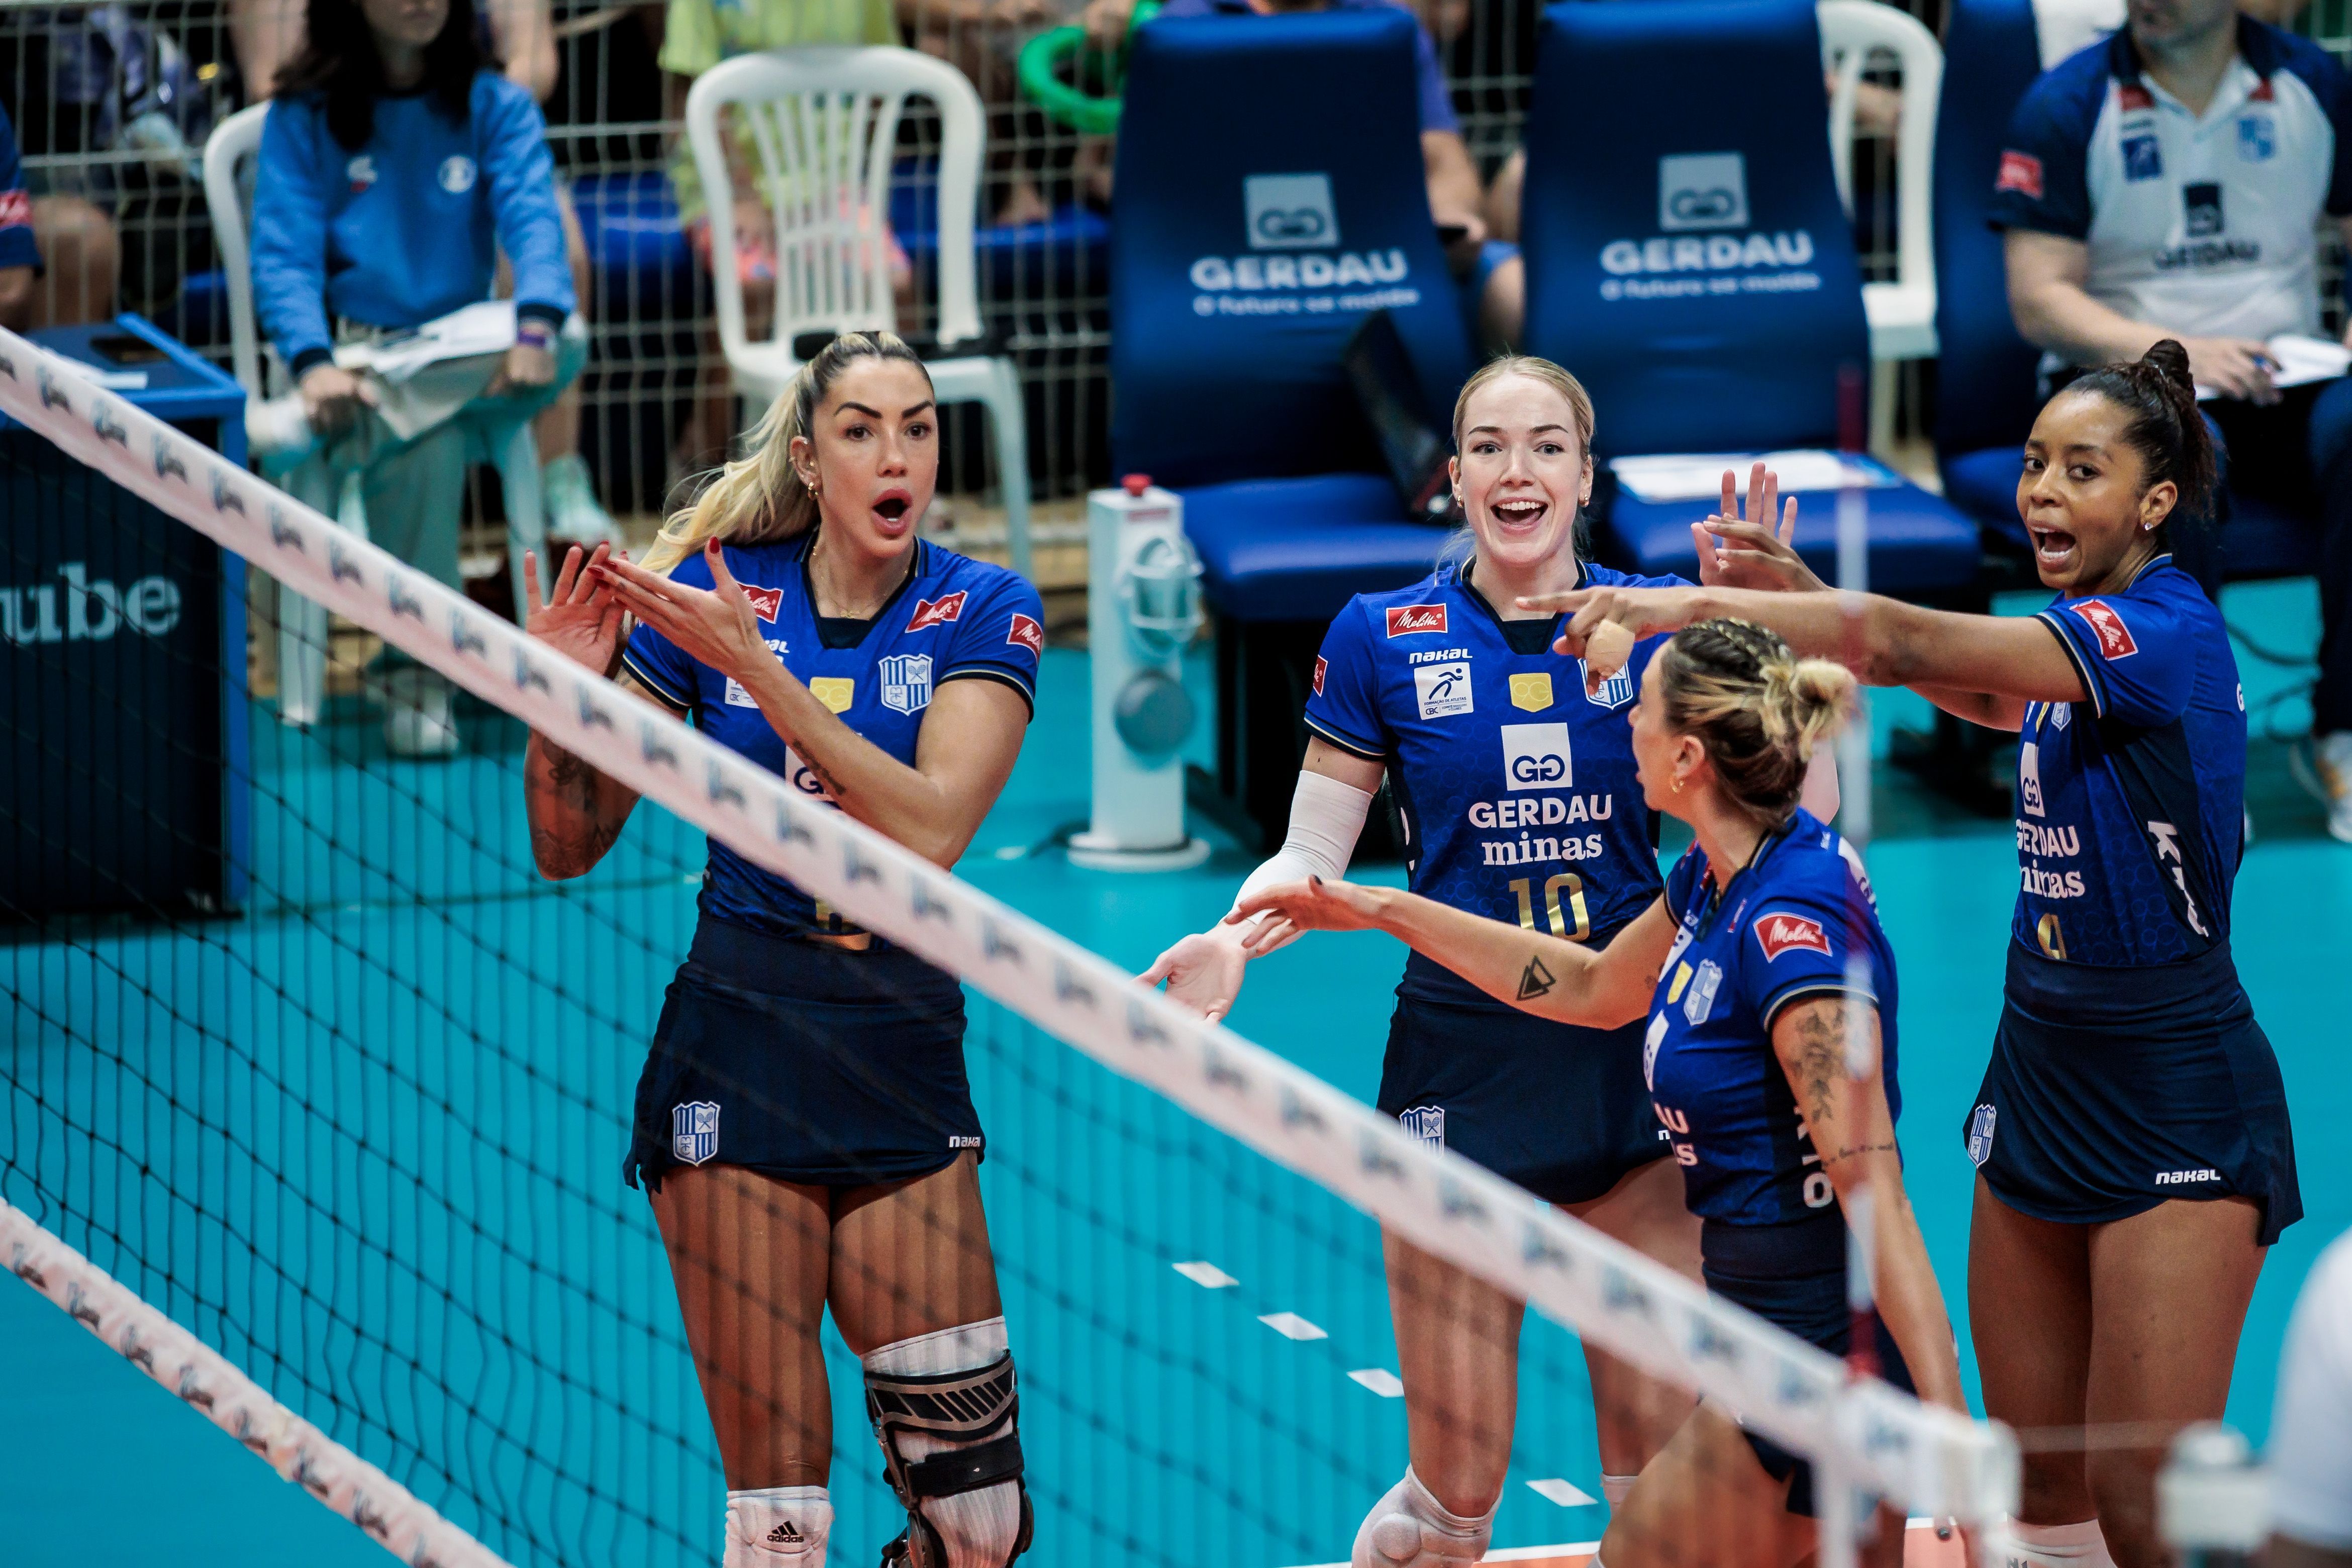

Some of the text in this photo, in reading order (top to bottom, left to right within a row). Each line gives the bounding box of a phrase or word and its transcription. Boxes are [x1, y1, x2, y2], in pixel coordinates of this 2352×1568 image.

[1192, 250, 1406, 288] GERDAU
[1602, 231, 1812, 273] GERDAU
[1394, 609, 1439, 629] Melitta
[1468, 795, 1612, 828] GERDAU
[1482, 831, 1602, 865] minas
[2016, 819, 2080, 857] GERDAU
[1509, 873, 1590, 942] 10
[767, 1534, 804, 1543] adidas
